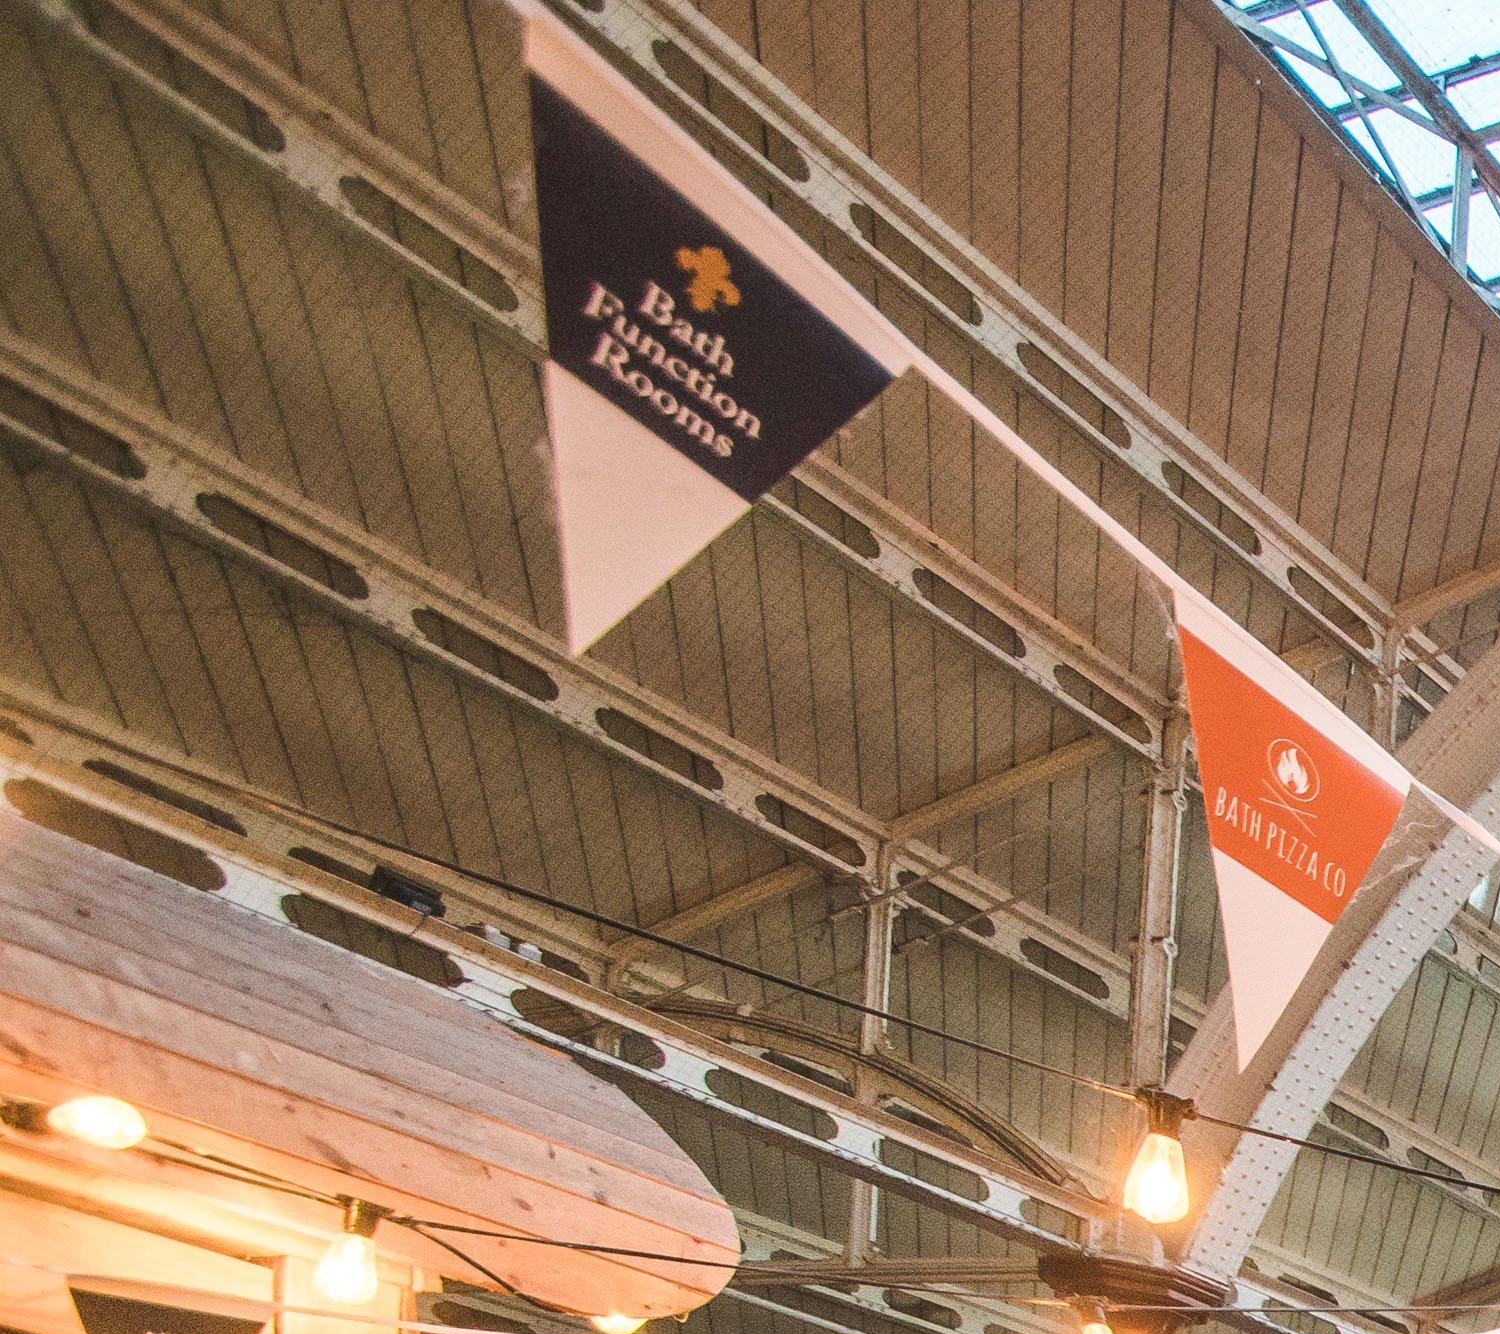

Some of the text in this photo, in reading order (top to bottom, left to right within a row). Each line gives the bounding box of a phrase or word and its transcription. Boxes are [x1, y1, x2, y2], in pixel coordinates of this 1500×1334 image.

[583, 280, 761, 440] Function
[639, 281, 734, 378] Bath
[591, 332, 734, 457] Rooms
[1215, 786, 1346, 897] BATH PIZZA CO
